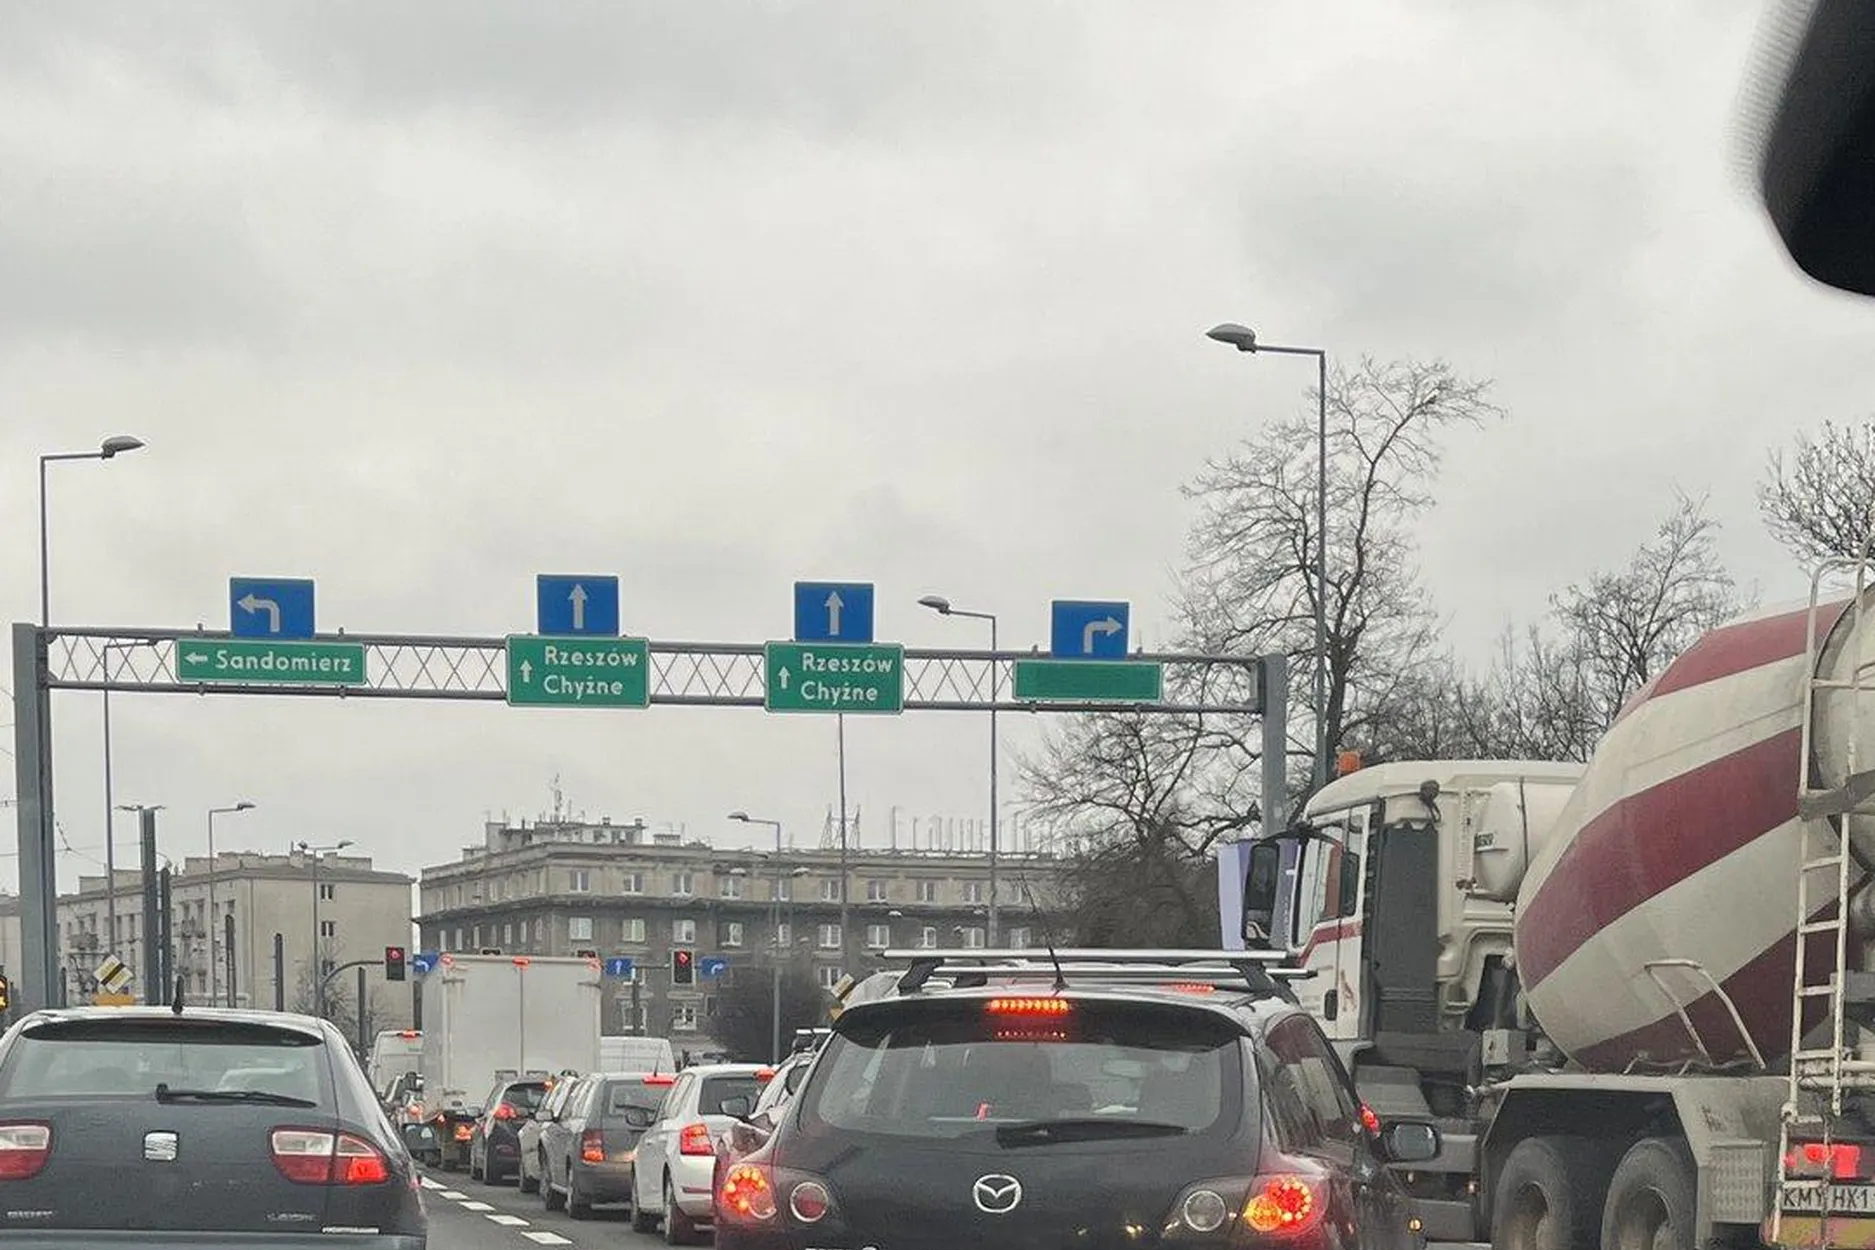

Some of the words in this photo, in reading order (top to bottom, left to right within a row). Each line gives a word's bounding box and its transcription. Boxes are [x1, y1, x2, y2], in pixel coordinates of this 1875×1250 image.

[215, 649, 351, 672] Sandomierz
[544, 645, 638, 667] Rzeszów
[802, 652, 893, 673] Rzeszów
[543, 674, 623, 700] Chyżne
[800, 680, 878, 705] Chyżne
[1832, 1187, 1875, 1209] HX1
